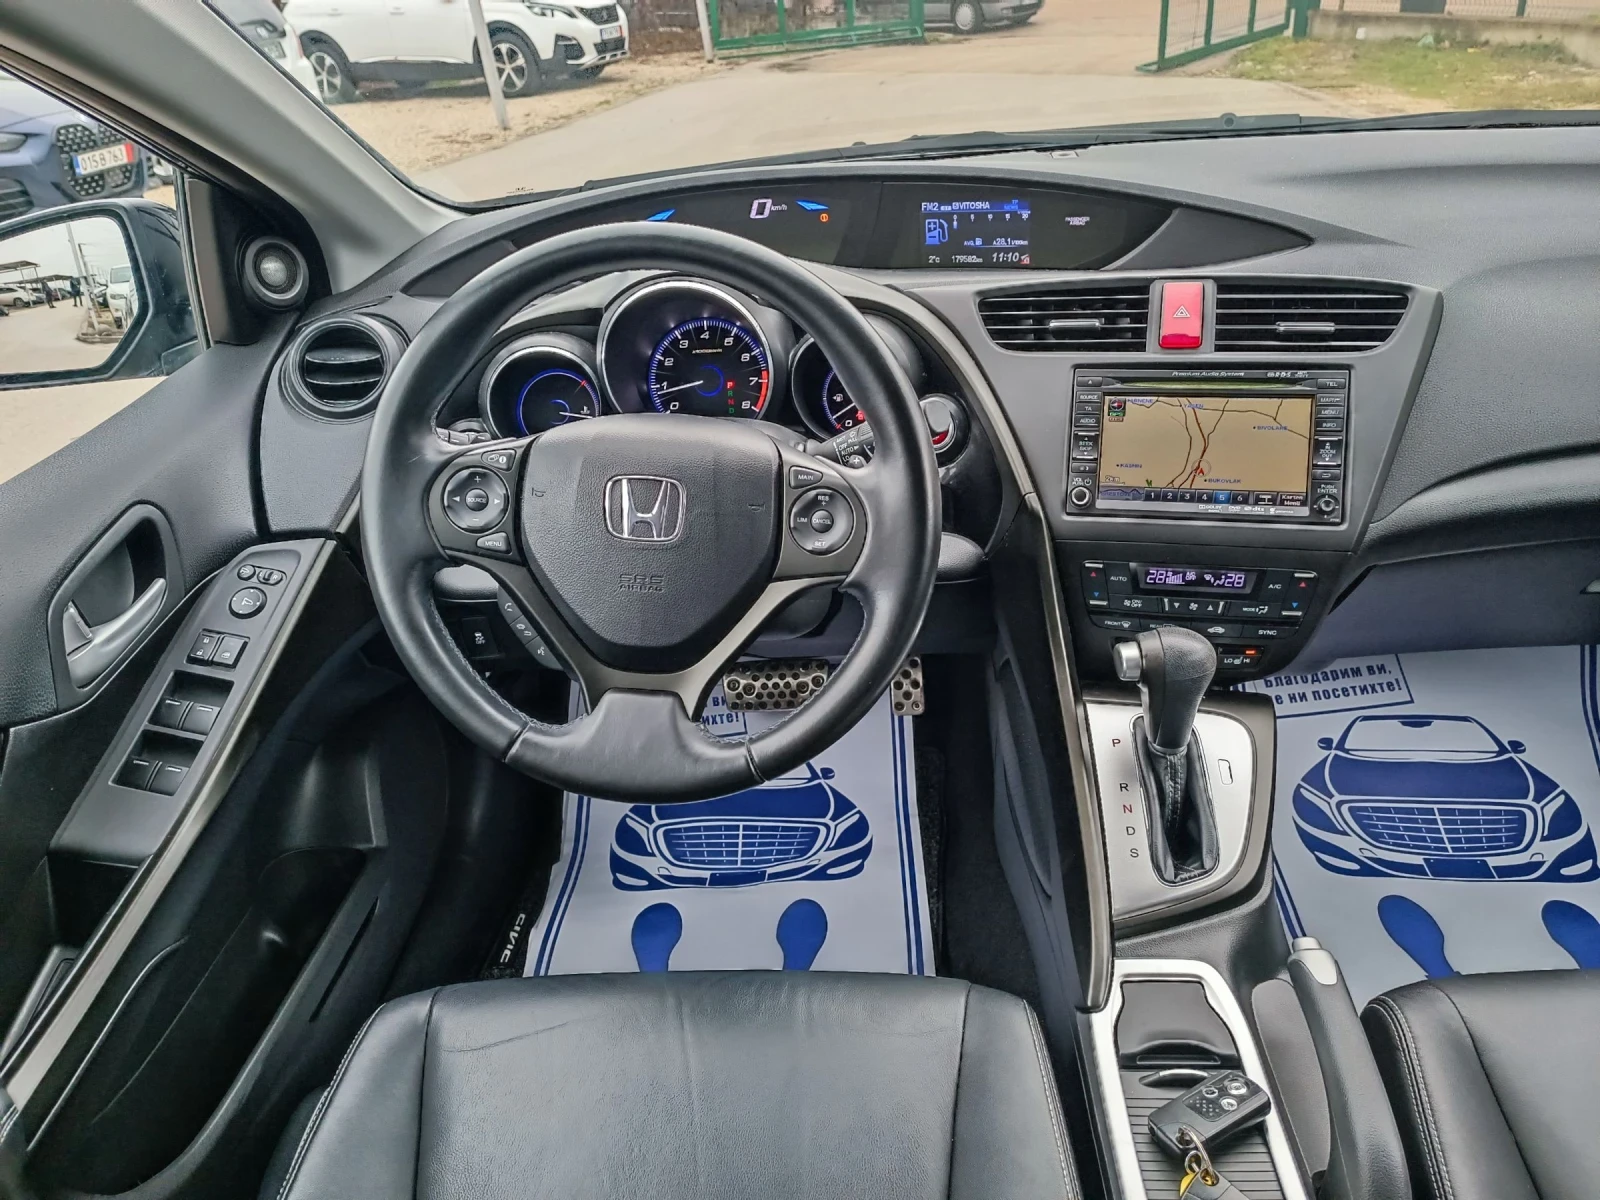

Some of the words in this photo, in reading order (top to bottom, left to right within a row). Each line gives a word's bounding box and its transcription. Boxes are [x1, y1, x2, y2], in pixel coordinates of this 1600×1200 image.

[750, 198, 772, 218] 0
[922, 202, 939, 211] FM2
[992, 252, 1019, 262] 11:10
[700, 331, 710, 339] 4
[679, 340, 688, 348] 3
[664, 357, 674, 366] 2
[741, 353, 750, 362] 6
[749, 377, 758, 386] 7
[670, 402, 679, 410] 0
[741, 401, 751, 409] 8
[467, 496, 487, 504] SOURCE
[1146, 570, 1166, 583] 28
[1224, 573, 1245, 587] 28
[1366, 663, 1392, 676] ви,
[1287, 691, 1308, 704] ни
[1312, 678, 1402, 701] посетихте!
[1111, 738, 1121, 747] P
[1119, 782, 1129, 792] R
[1122, 804, 1132, 813] N
[1126, 826, 1135, 835] D
[1130, 848, 1139, 858] S
[500, 913, 526, 963] CIVIC
